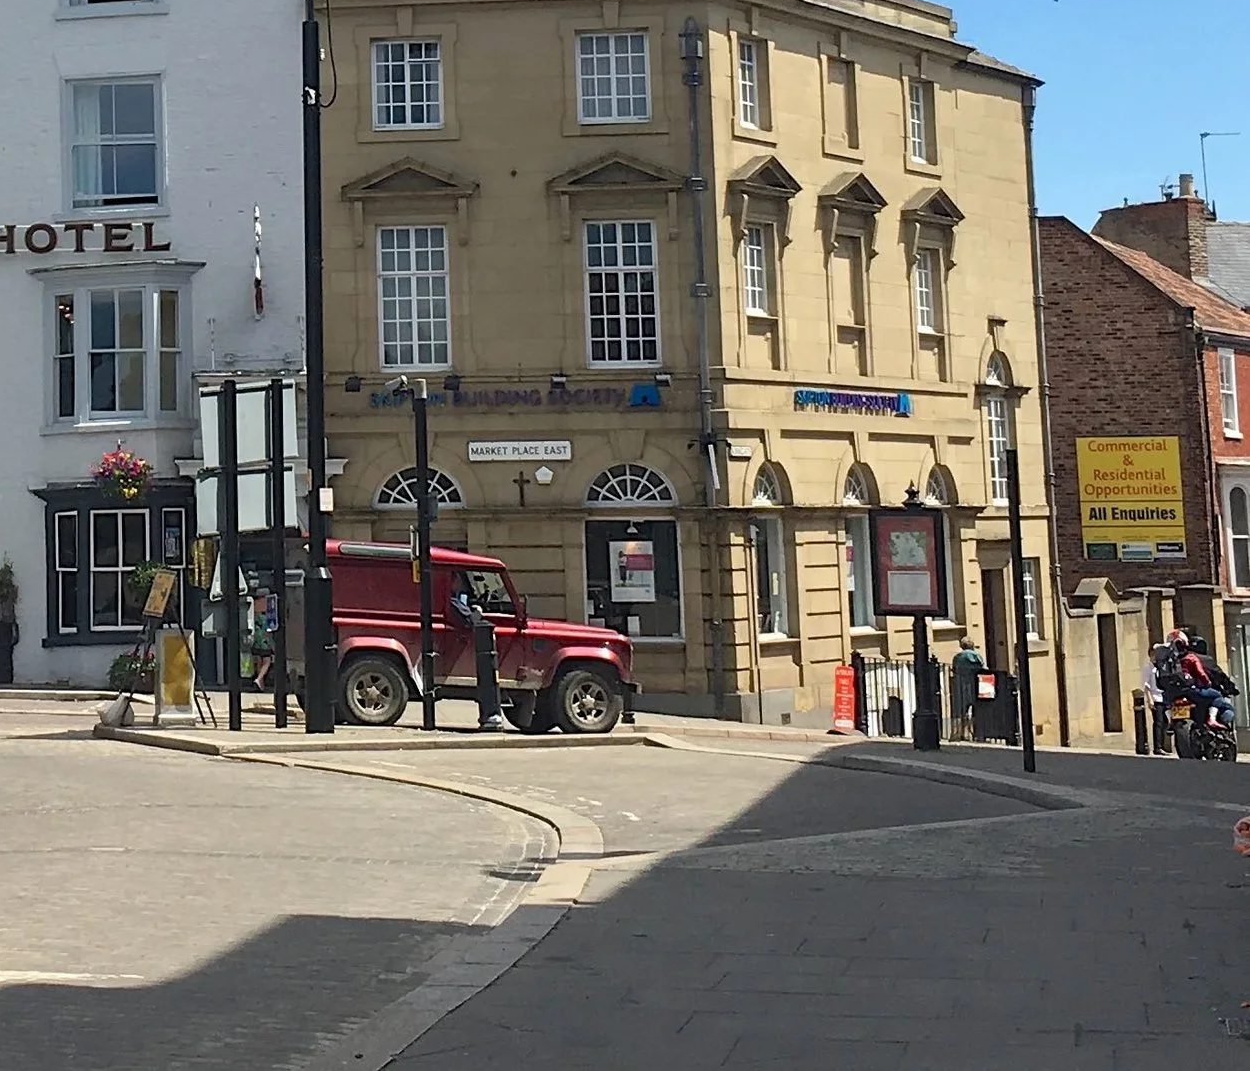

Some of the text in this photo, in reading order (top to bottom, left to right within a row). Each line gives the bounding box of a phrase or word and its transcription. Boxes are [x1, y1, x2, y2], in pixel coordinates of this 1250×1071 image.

[453, 388, 542, 407] BUILDING
[547, 387, 626, 406] SOCIETY
[470, 445, 568, 456] MARKET PLACE EAST
[1088, 439, 1168, 452] Commercial
[1122, 454, 1134, 466] &
[1093, 467, 1166, 481] Residential
[1084, 483, 1178, 499] Opportunities
[1089, 507, 1177, 522] All Enquiries
